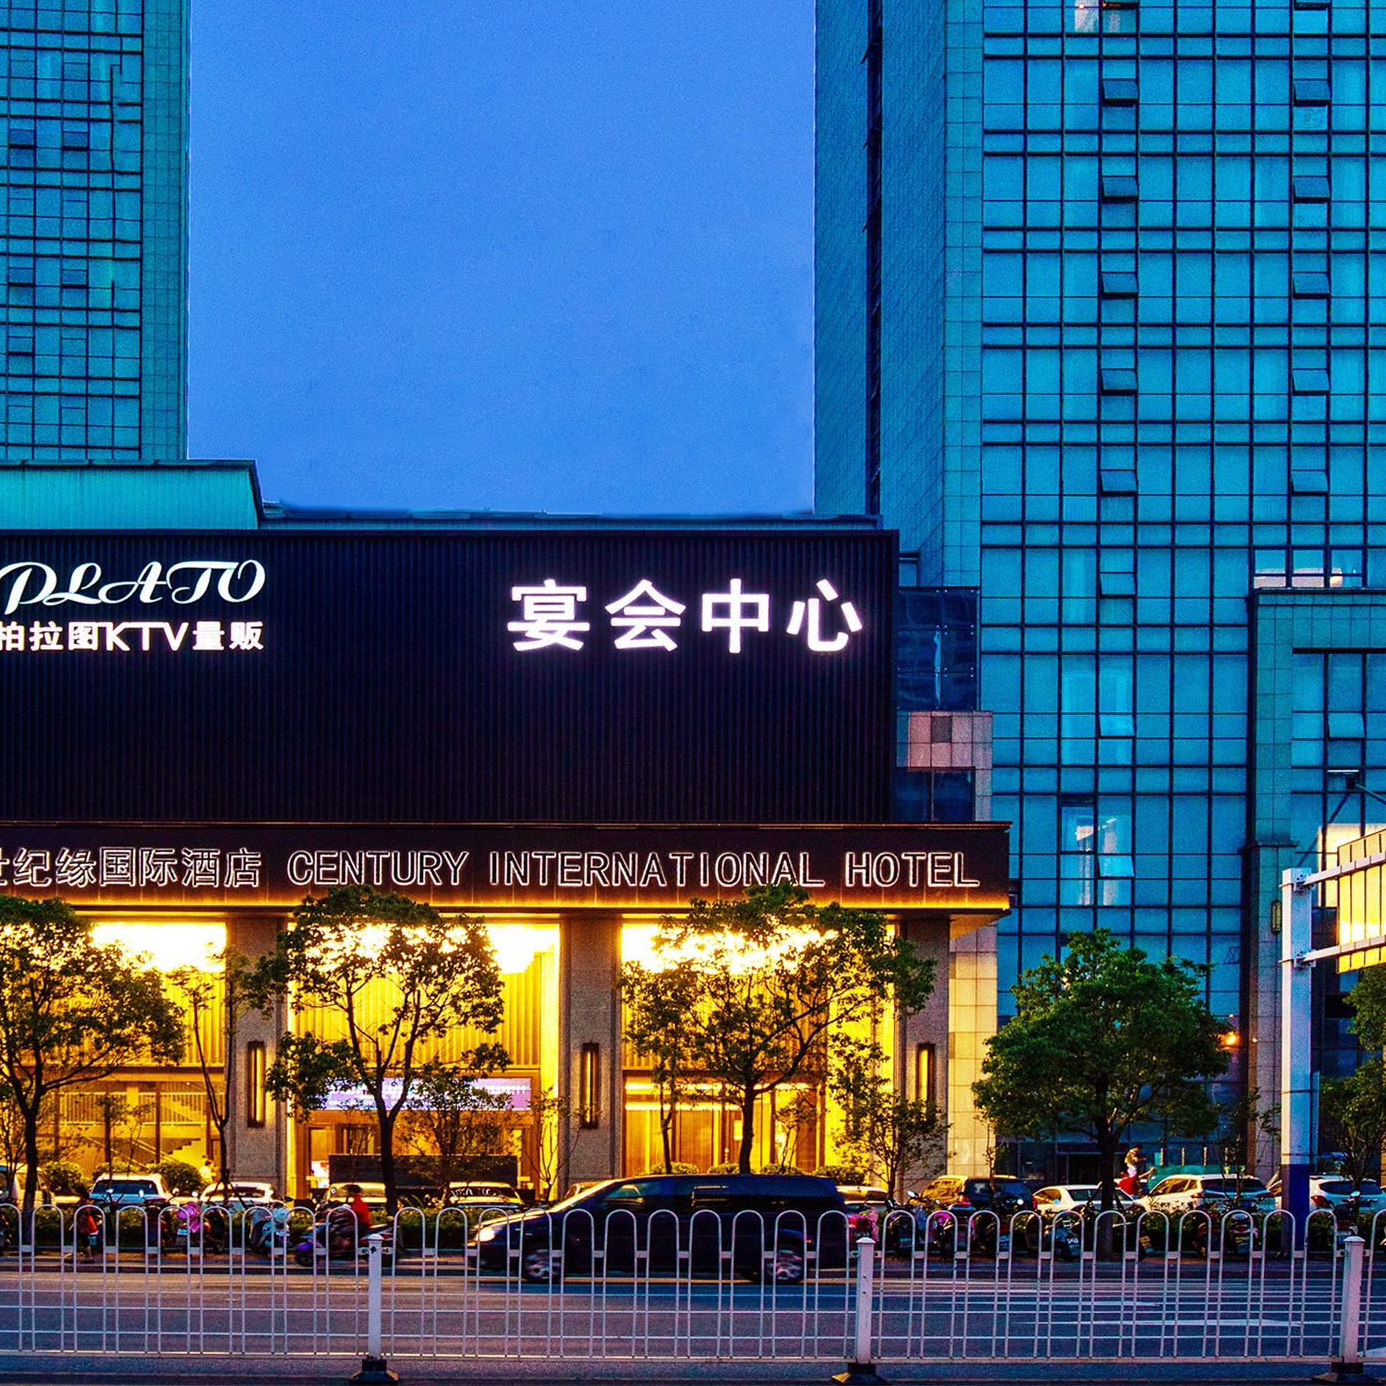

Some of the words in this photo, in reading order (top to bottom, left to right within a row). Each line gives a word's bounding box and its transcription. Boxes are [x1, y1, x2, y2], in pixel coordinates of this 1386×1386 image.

[506, 577, 864, 654] 宴会中心
[286, 849, 471, 887] CENTURY
[488, 850, 826, 888] INTERNATIONAL
[844, 850, 981, 888] HOTEL
